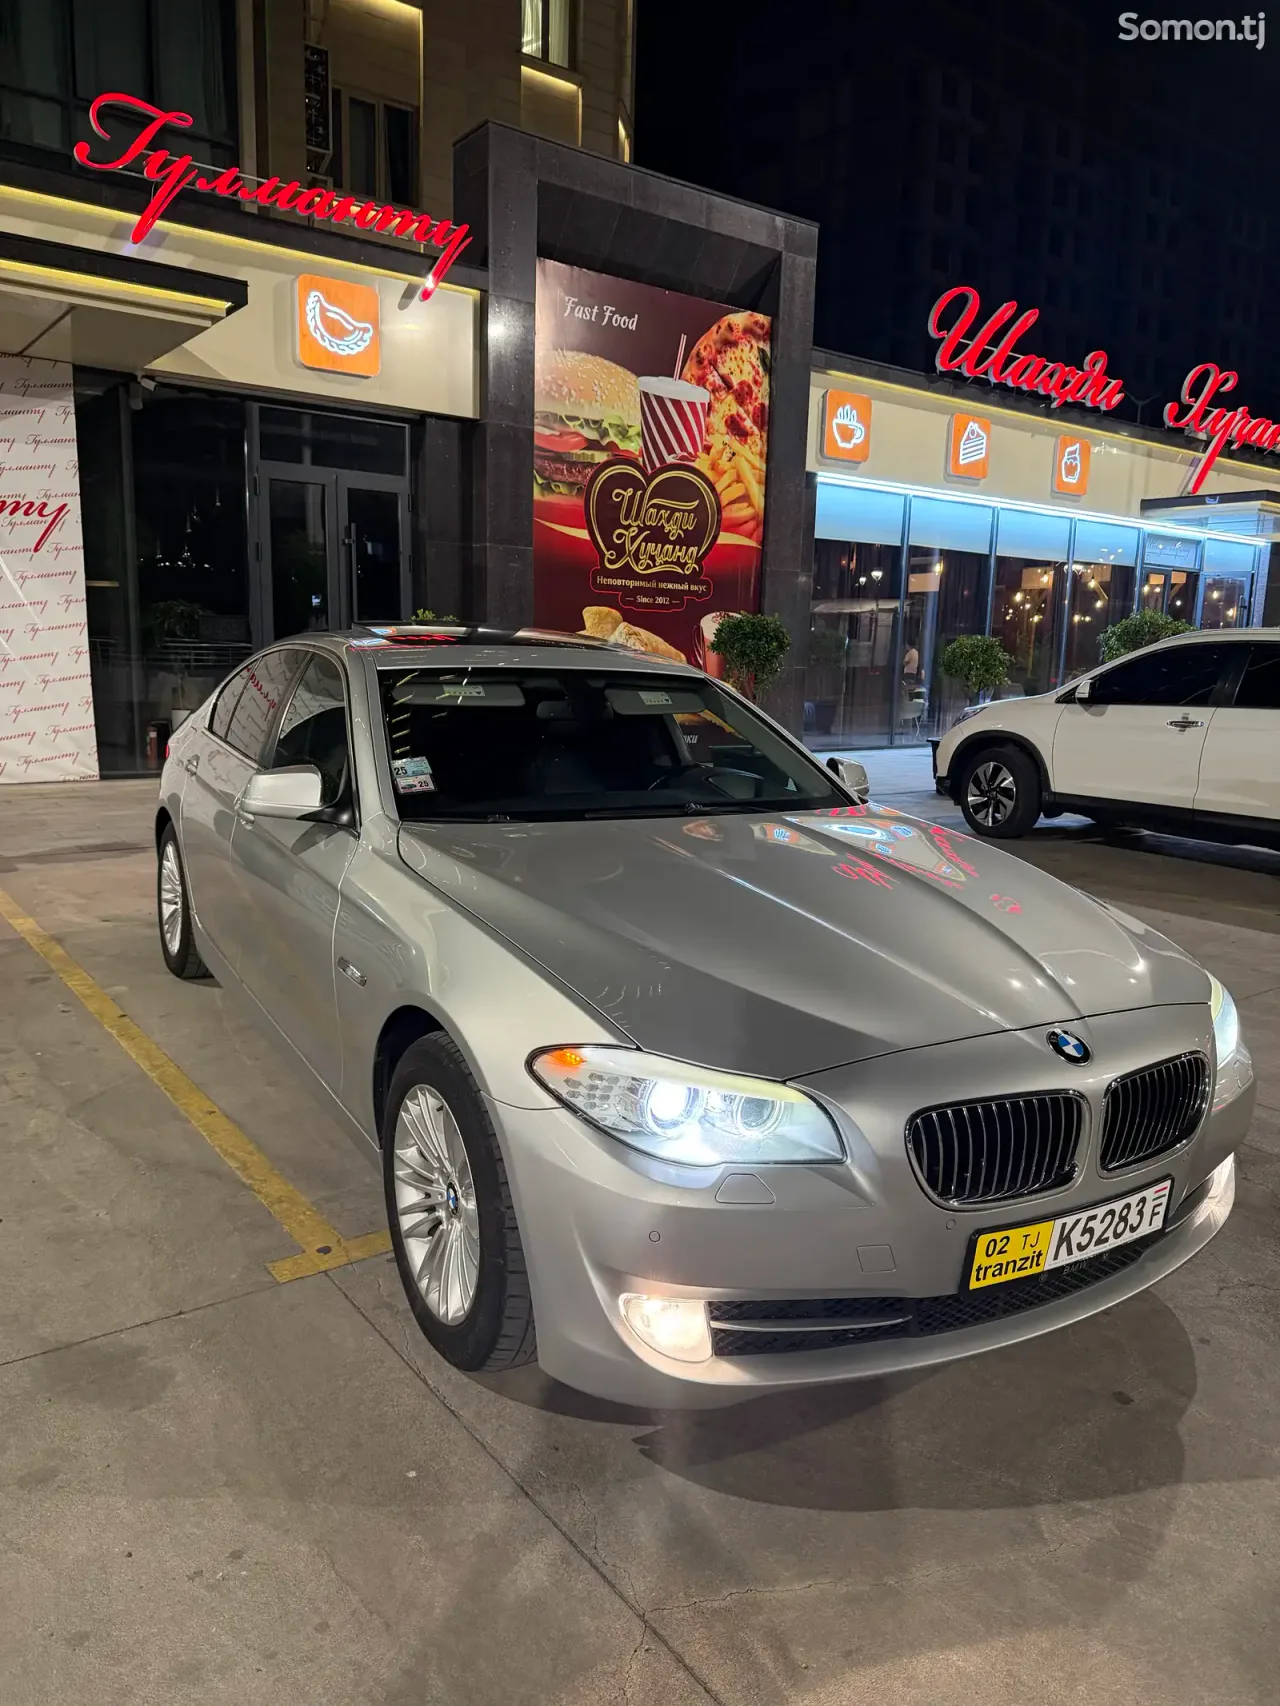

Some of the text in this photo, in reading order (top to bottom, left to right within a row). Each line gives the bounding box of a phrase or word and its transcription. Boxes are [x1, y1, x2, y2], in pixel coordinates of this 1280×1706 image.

[73, 92, 473, 301] Гулманту
[564, 296, 639, 331] Fast Food
[596, 575, 708, 594] Неповторимый нежный вкус
[636, 595, 670, 605] Since 2012
[394, 767, 408, 776] 25
[1052, 1195, 1147, 1261] K5283
[1149, 1202, 1164, 1227] F
[985, 1235, 1011, 1258] 02
[1022, 1231, 1041, 1250] TJ
[975, 1250, 1043, 1282] tranzit
